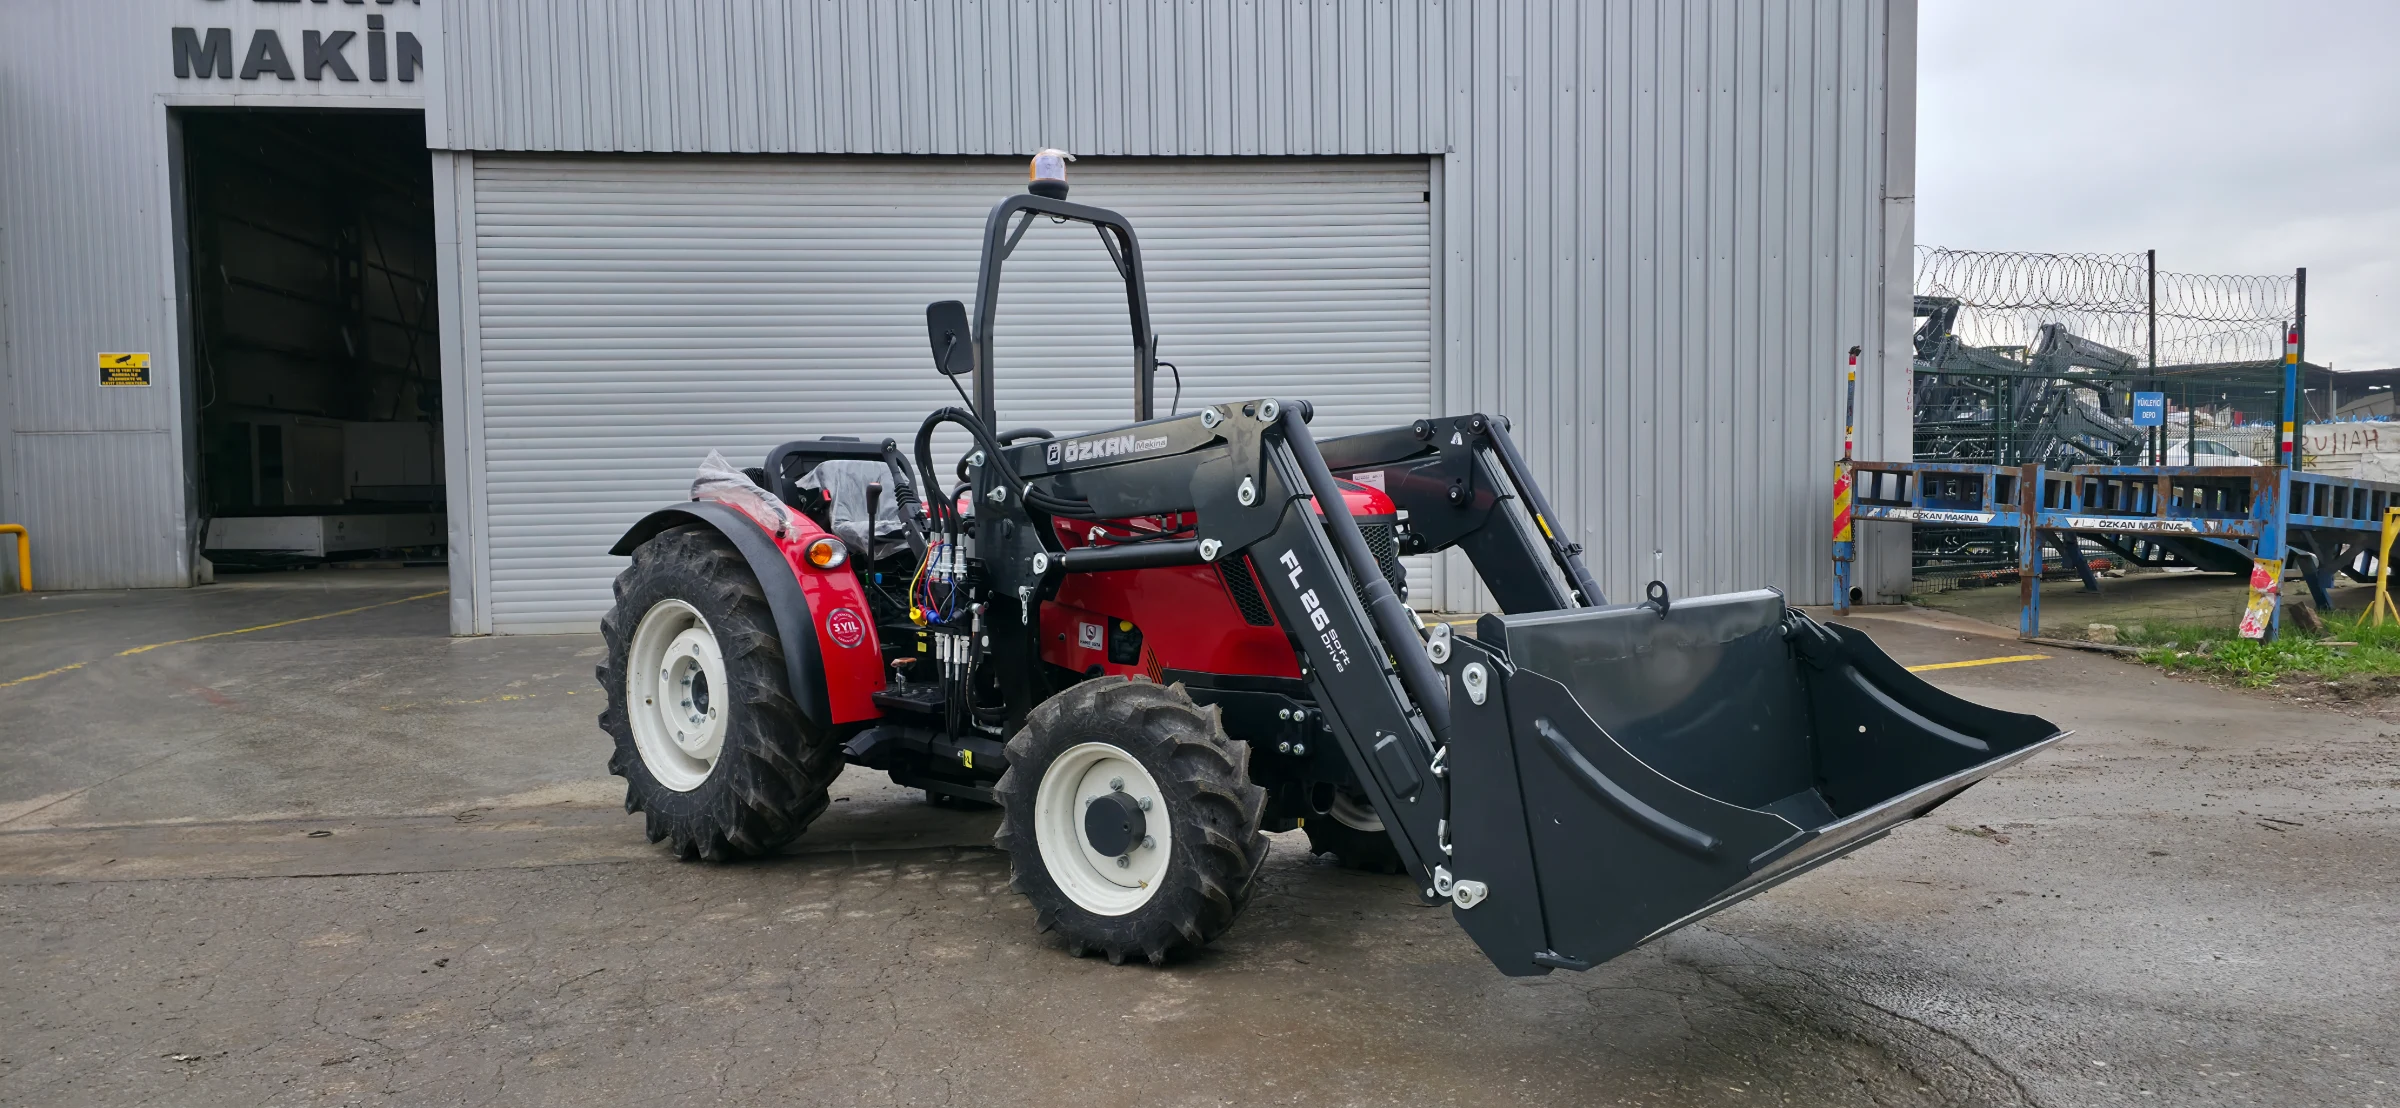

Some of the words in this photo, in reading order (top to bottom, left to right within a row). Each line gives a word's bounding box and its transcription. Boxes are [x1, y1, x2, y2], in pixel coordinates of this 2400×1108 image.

[2142, 411, 2156, 419] DEPO
[1064, 434, 1136, 463] ÖZKAN
[1136, 438, 1166, 451] Makina
[2098, 519, 2136, 529] ÖZKAN
[2138, 520, 2184, 531] MAİNA
[1279, 549, 1303, 590] FL
[1300, 588, 1330, 631] 26
[833, 623, 841, 632] 3
[840, 621, 860, 631] YIL
[1320, 633, 1344, 673] Drive
[1328, 628, 1350, 665] Soft
